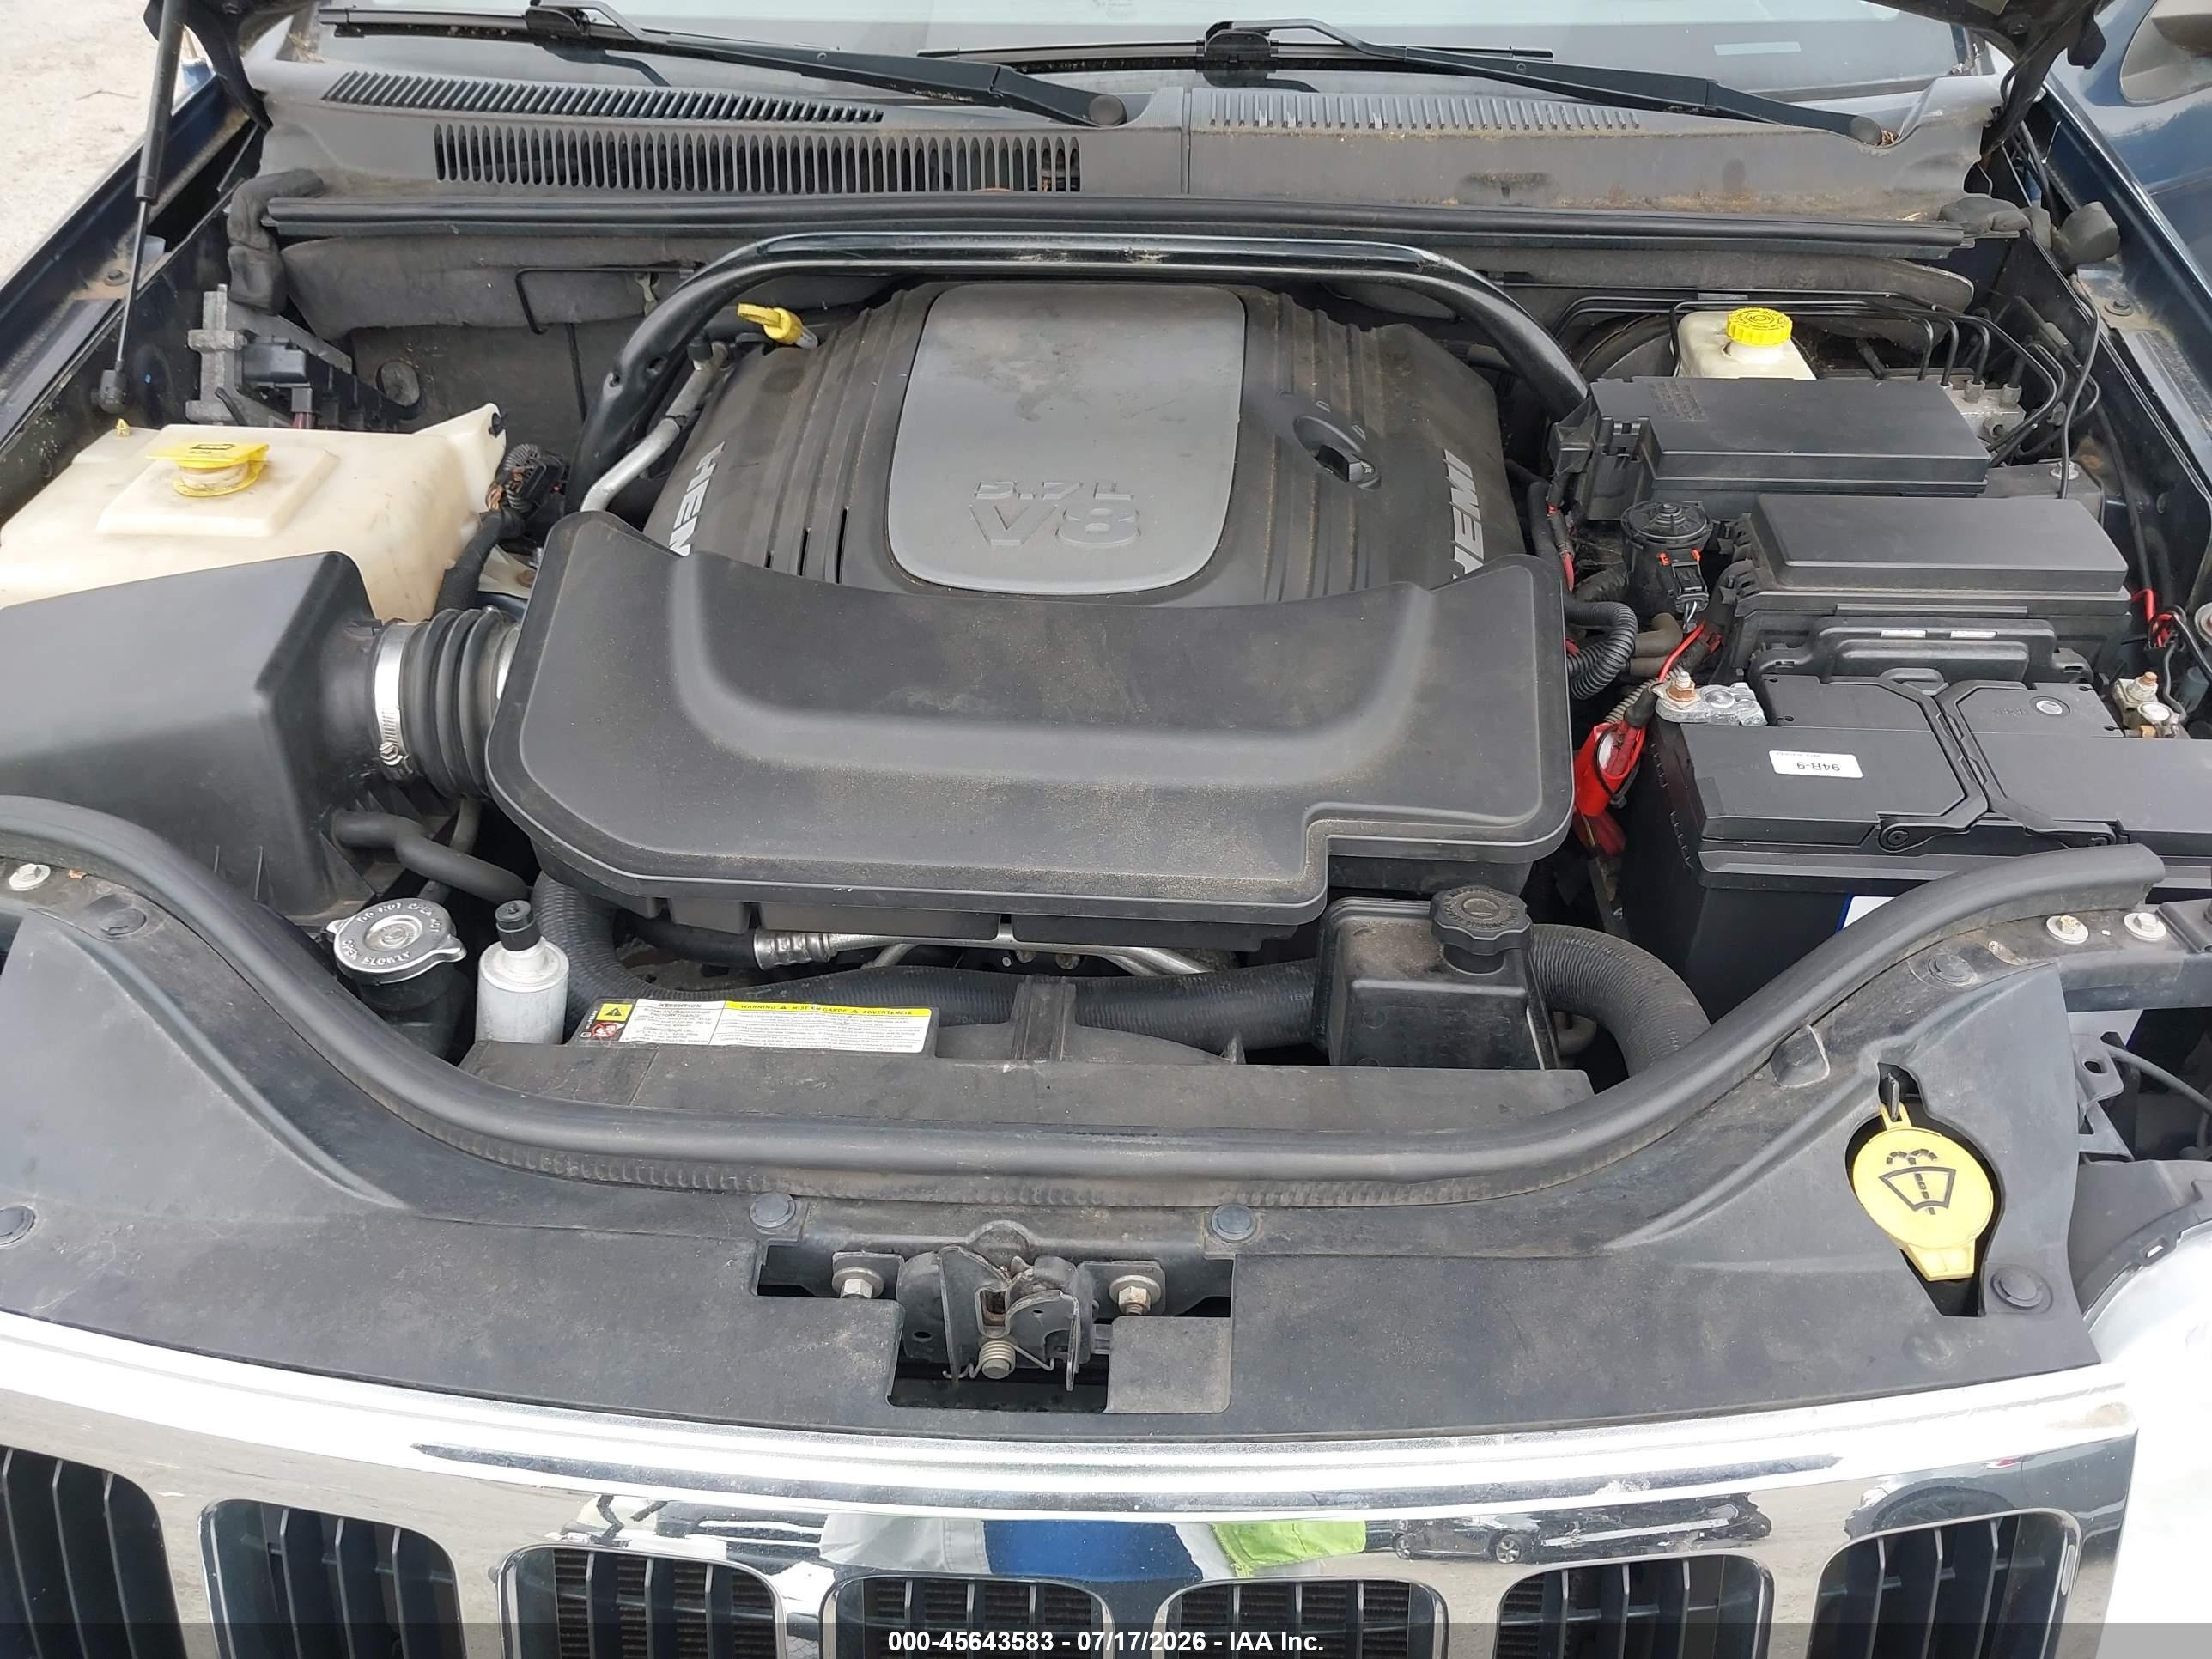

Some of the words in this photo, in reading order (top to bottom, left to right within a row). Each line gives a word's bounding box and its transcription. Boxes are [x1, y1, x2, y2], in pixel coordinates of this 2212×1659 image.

[668, 441, 726, 557] HEM
[974, 480, 1135, 501] 5.7L
[968, 500, 1142, 547] V8
[1796, 761, 1842, 772] 94R-9
